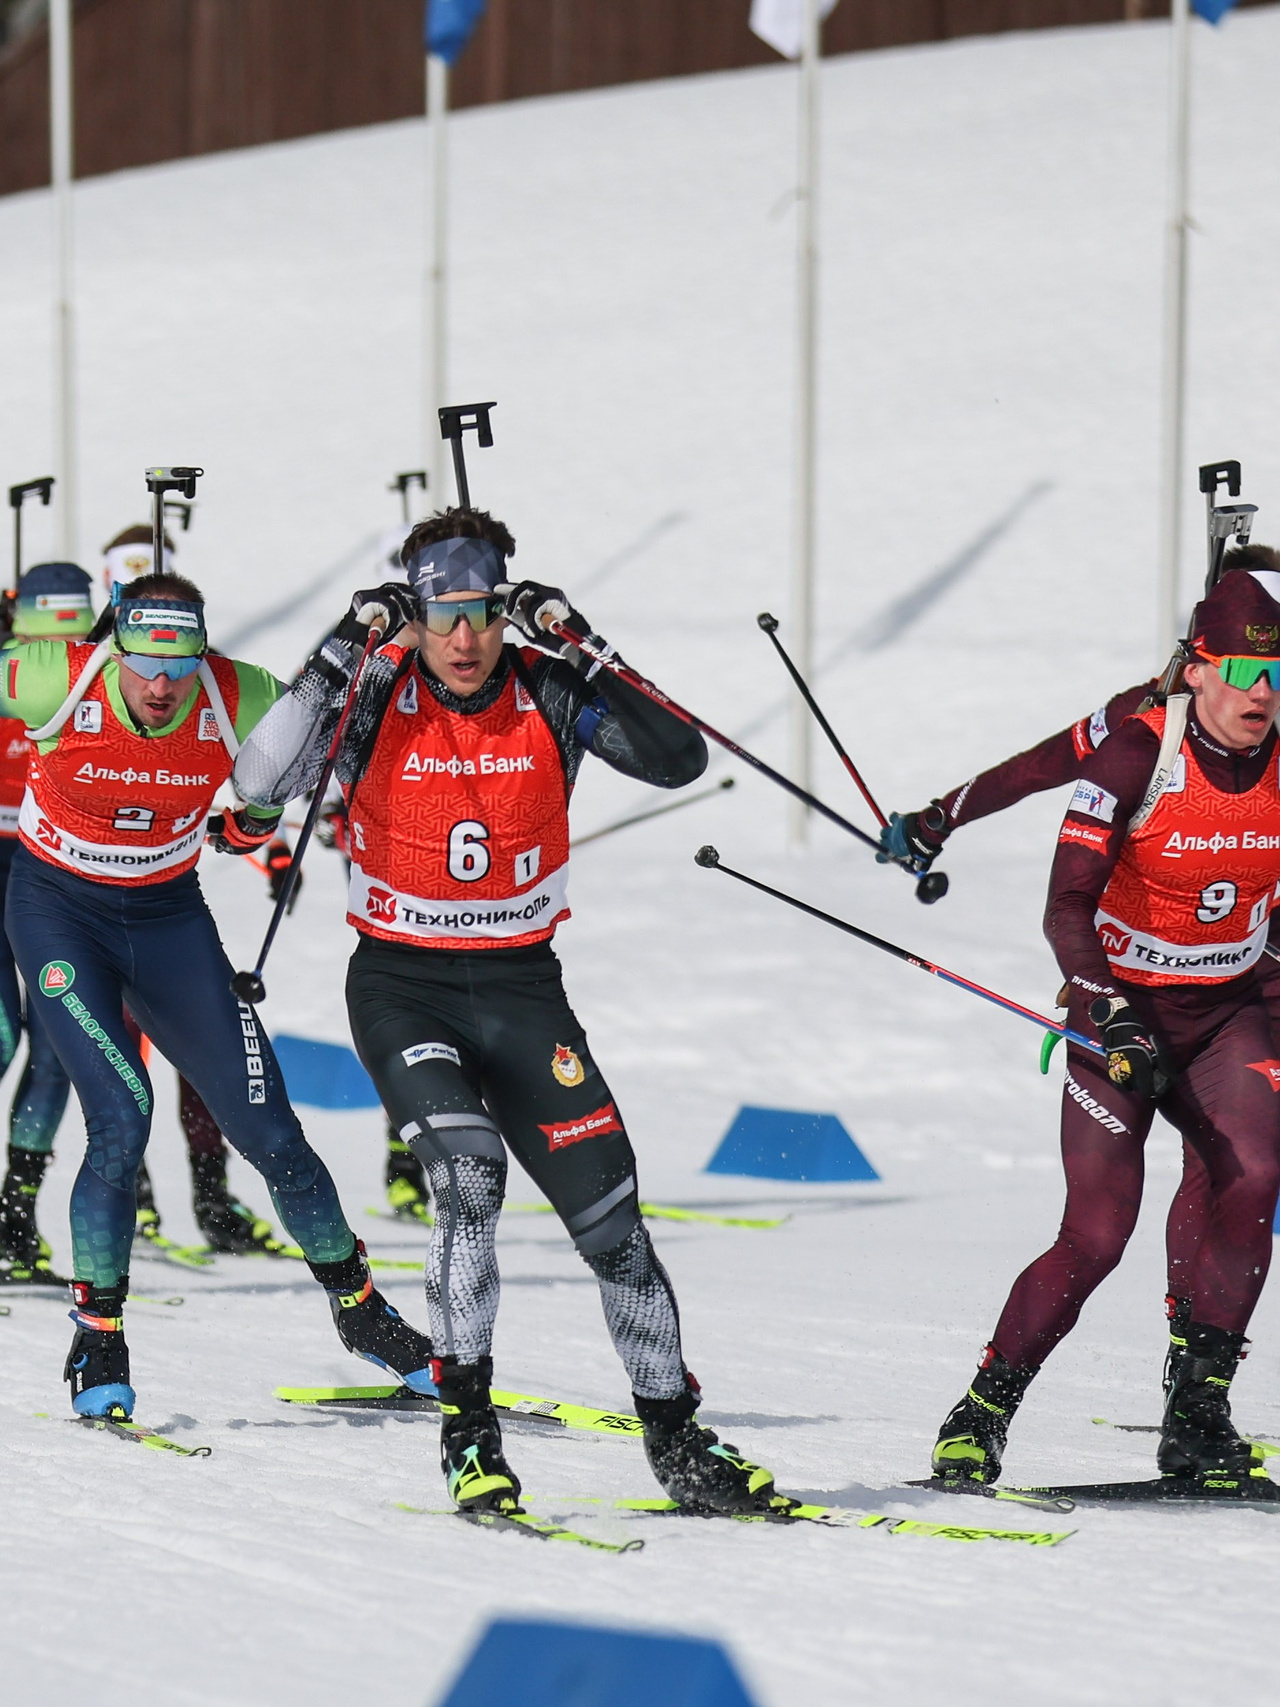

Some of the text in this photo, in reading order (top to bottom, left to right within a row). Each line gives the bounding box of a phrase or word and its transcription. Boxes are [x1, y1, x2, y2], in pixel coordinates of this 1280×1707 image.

[73, 761, 211, 786] Альфа Банк
[401, 752, 536, 781] Альфа Банк
[1143, 767, 1168, 810] LARSEN
[112, 806, 155, 832] 2
[448, 819, 492, 883] 6
[1082, 829, 1104, 844] Банк
[1161, 831, 1280, 858] Альфа Бан
[522, 854, 531, 877] 1
[402, 893, 550, 928] ТЕХНОНИКОЛЬ
[1195, 879, 1239, 925] 9
[61, 991, 150, 1116] БЕЛОРУСНЕФТЬ
[552, 1114, 613, 1144] Альфа Банк
[1202, 1479, 1239, 1489] FISCHER
